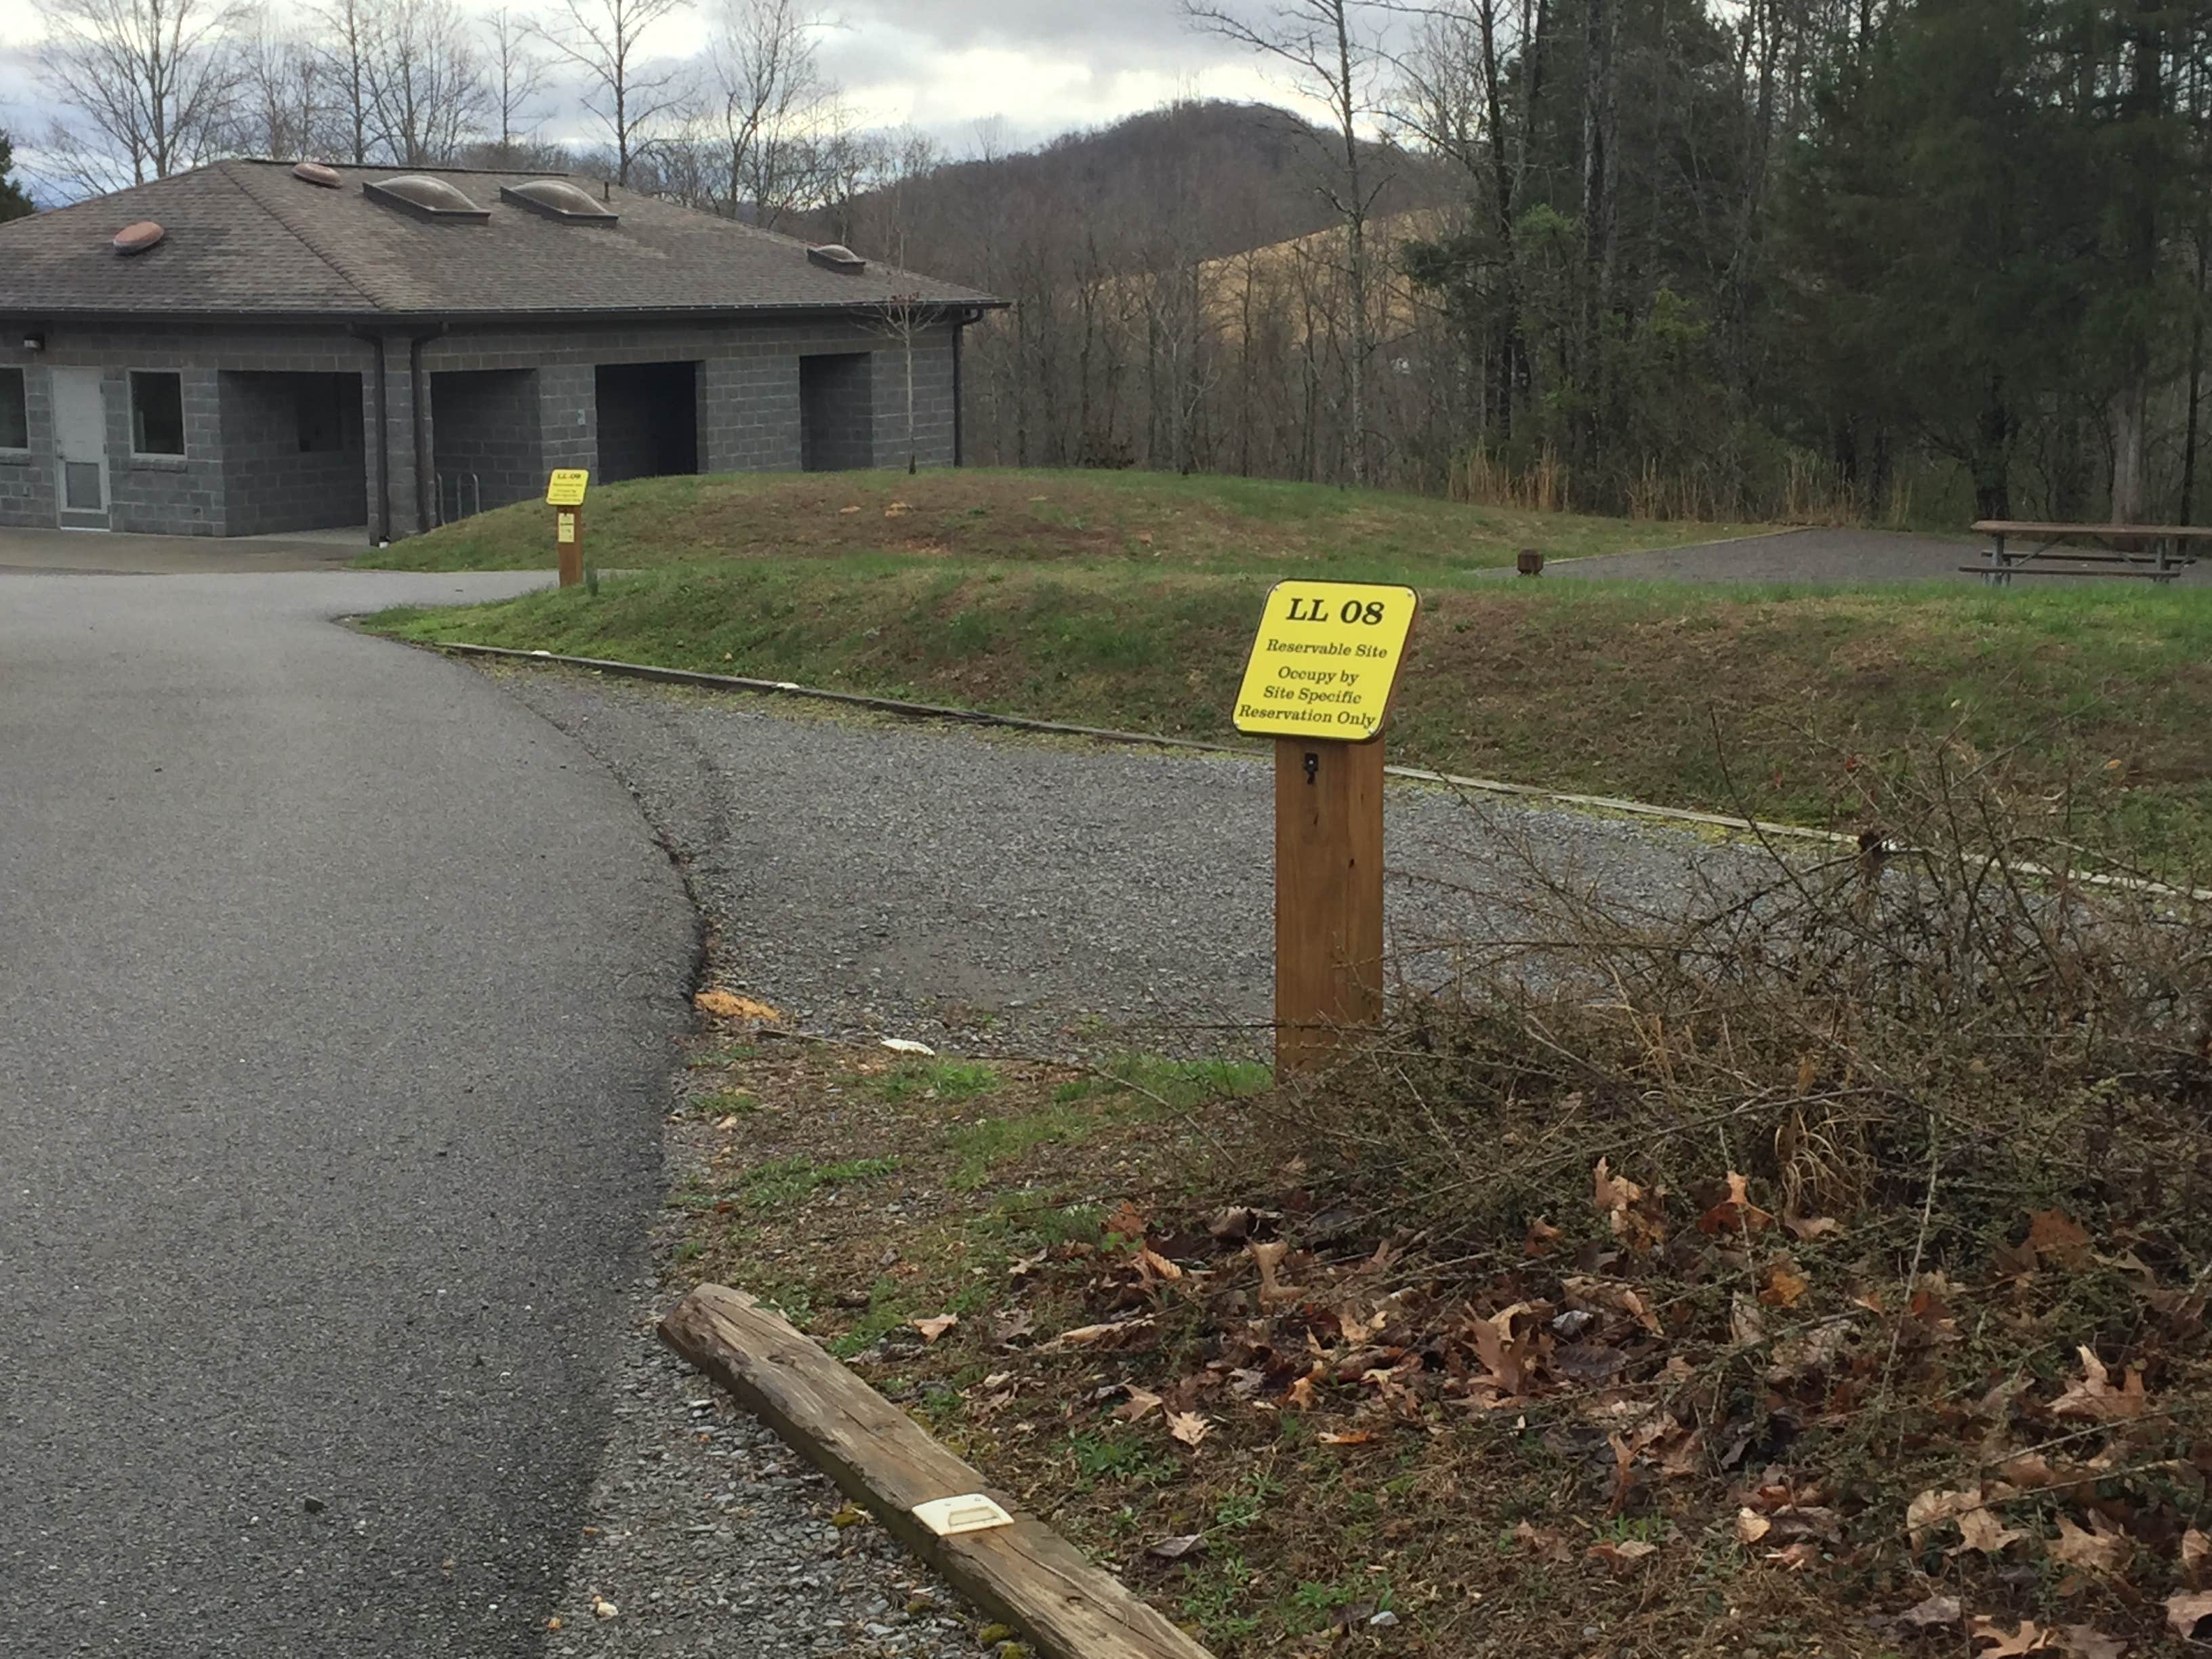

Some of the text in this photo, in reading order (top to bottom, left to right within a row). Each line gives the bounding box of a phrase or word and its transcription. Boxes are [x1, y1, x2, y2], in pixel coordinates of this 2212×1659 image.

[1286, 598, 1385, 626] LL 08
[1266, 639, 1387, 659] Reservable Site
[1278, 665, 1359, 687] Occupy by
[1263, 685, 1361, 705] Site Specific
[1238, 704, 1376, 729] Reservation Only
